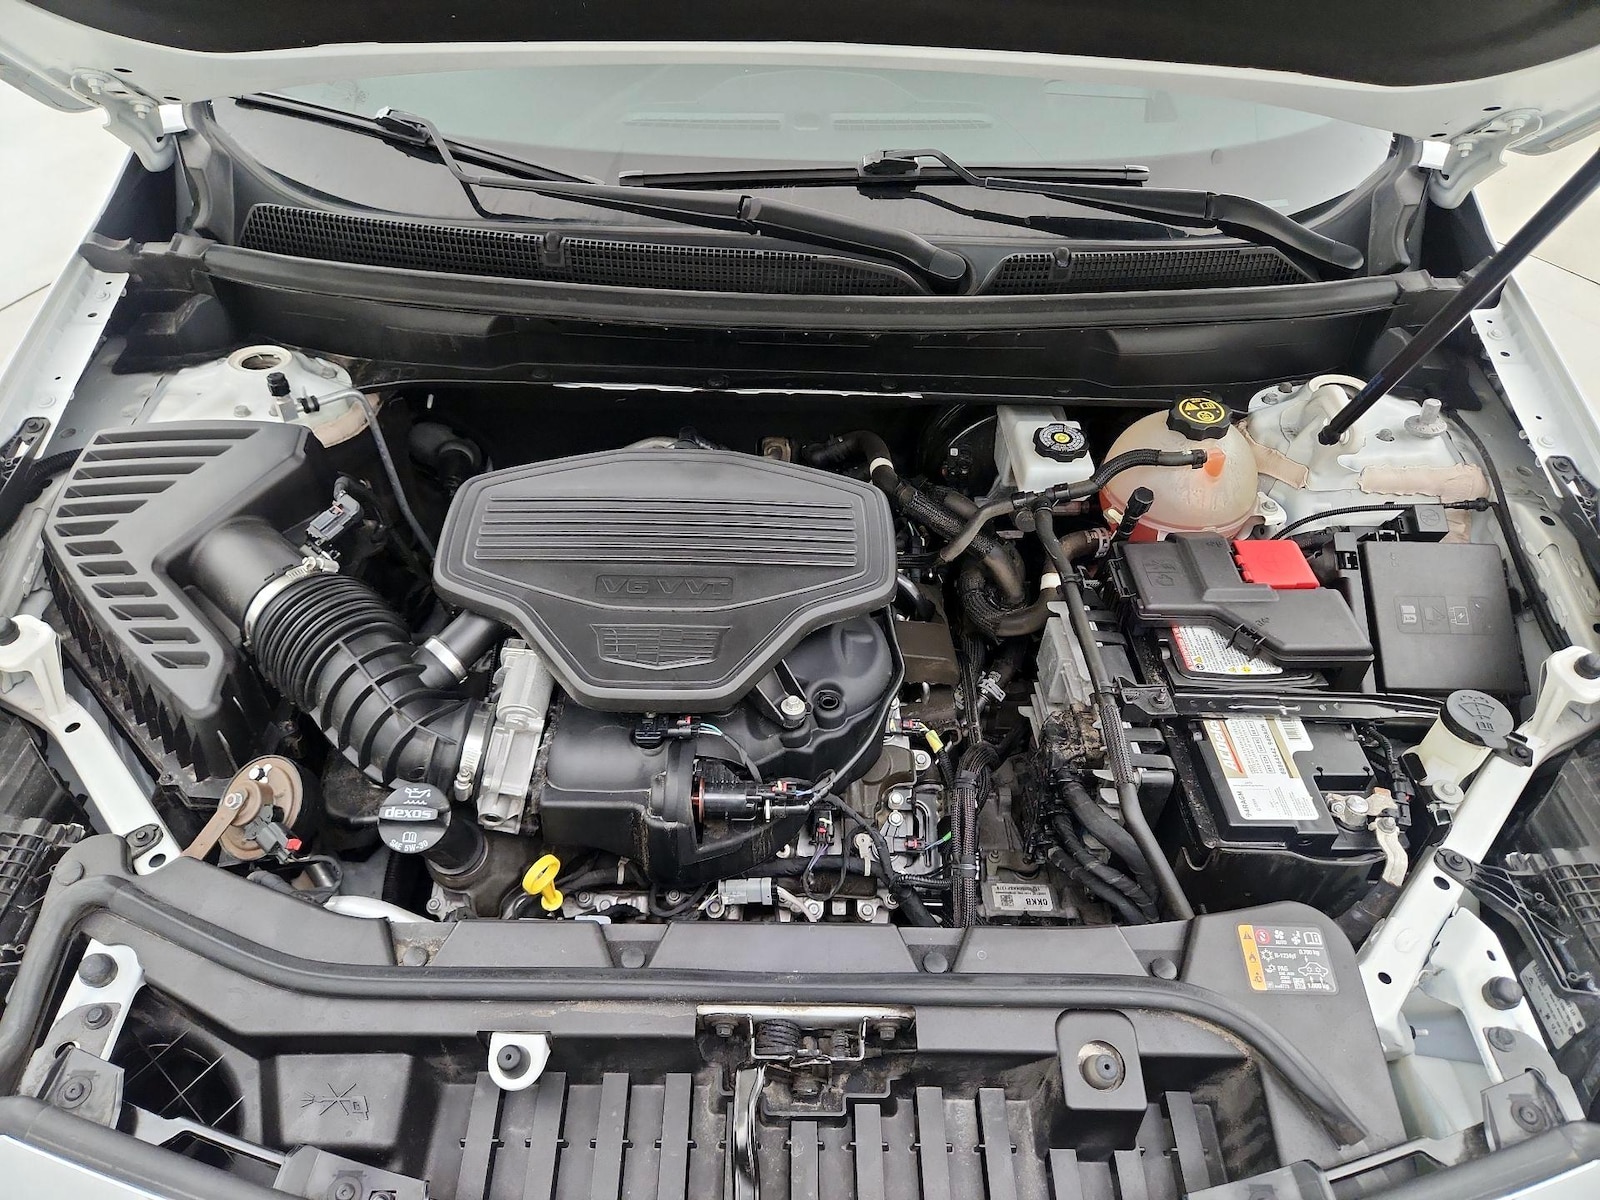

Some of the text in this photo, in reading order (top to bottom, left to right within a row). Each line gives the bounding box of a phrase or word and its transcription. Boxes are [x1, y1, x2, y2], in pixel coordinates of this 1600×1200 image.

[602, 578, 729, 595] V6 VVT
[1210, 719, 1238, 770] ACDelc
[384, 806, 432, 818] dexos
[389, 839, 429, 852] SAE 5W-30
